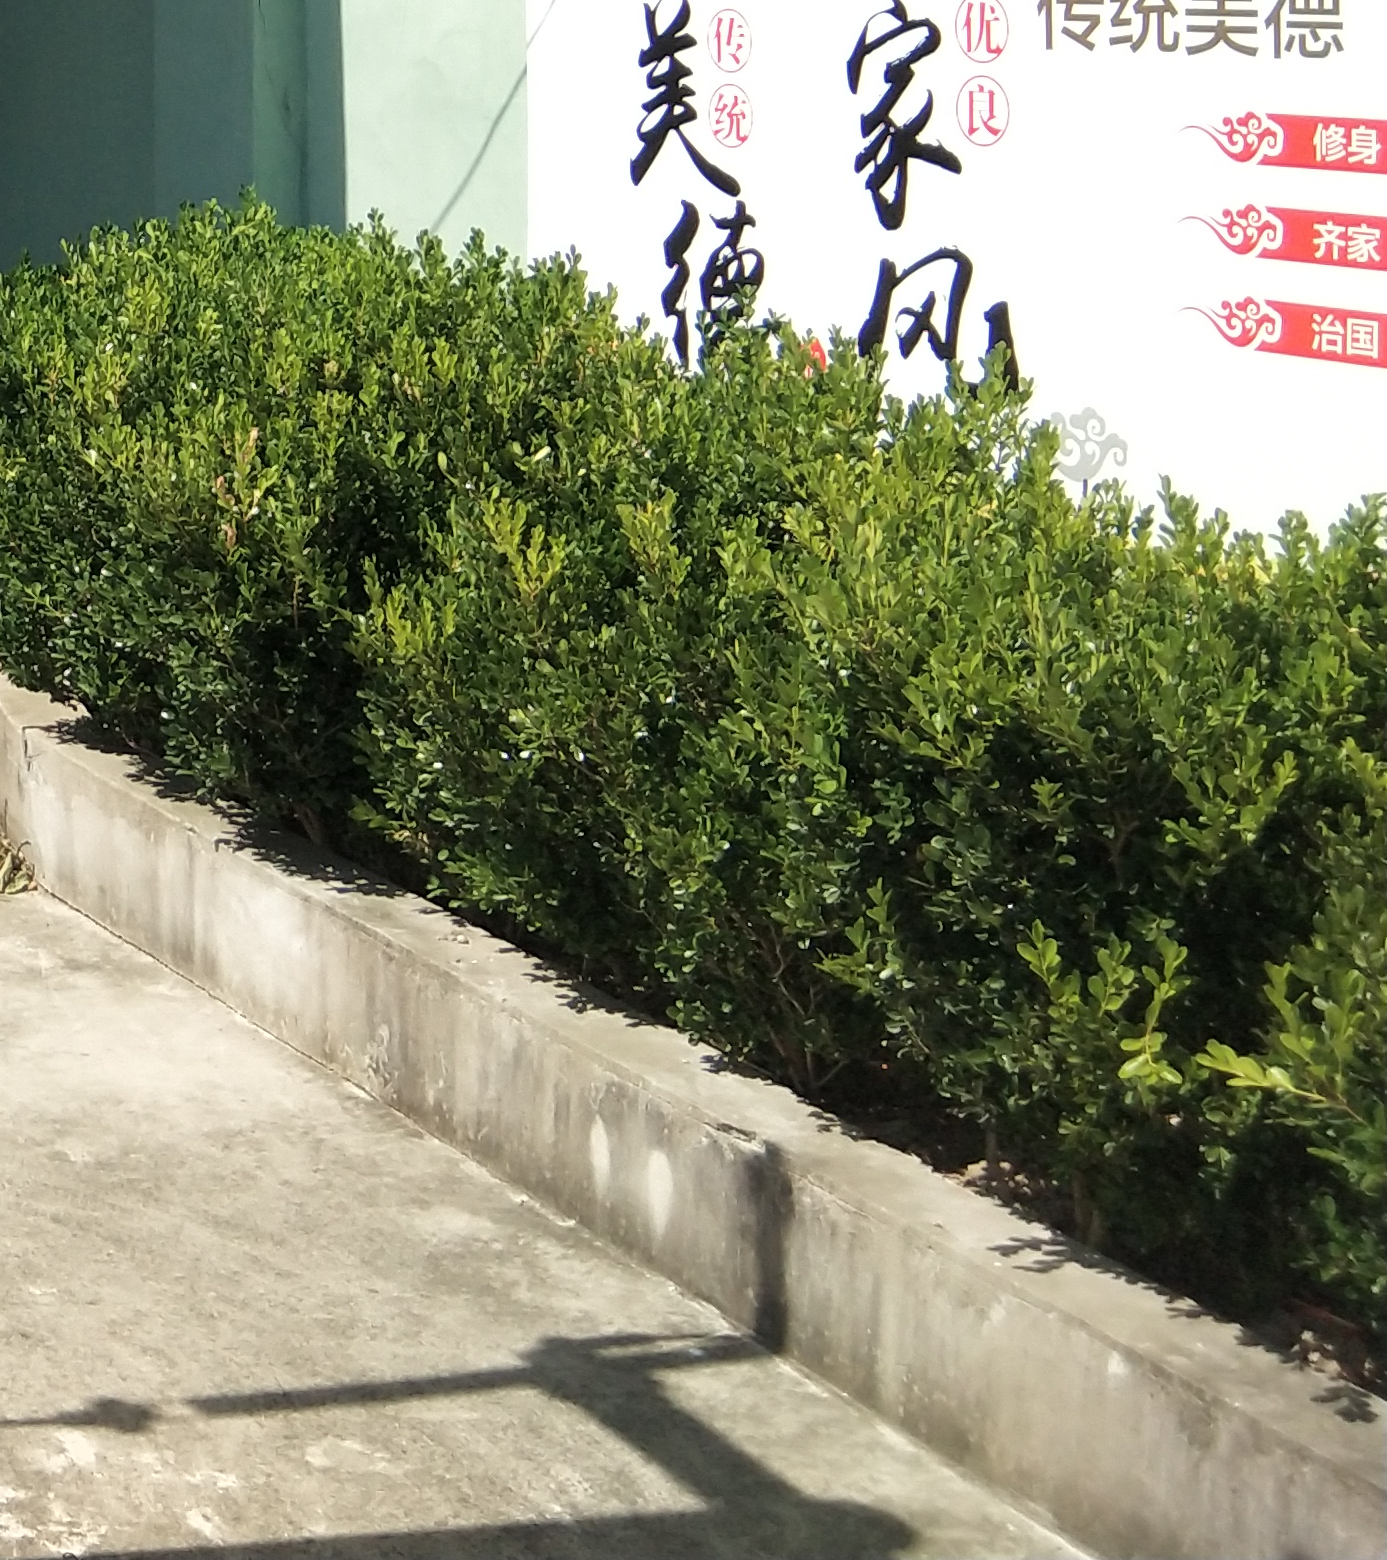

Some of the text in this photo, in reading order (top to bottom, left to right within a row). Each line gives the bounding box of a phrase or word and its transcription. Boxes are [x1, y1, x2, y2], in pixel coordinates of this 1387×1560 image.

[712, 15, 750, 144] 传统
[962, 1, 1004, 138] 优良
[1312, 122, 1382, 165] 修身
[1312, 220, 1382, 263] 齐家
[1311, 313, 1380, 359] 治国
